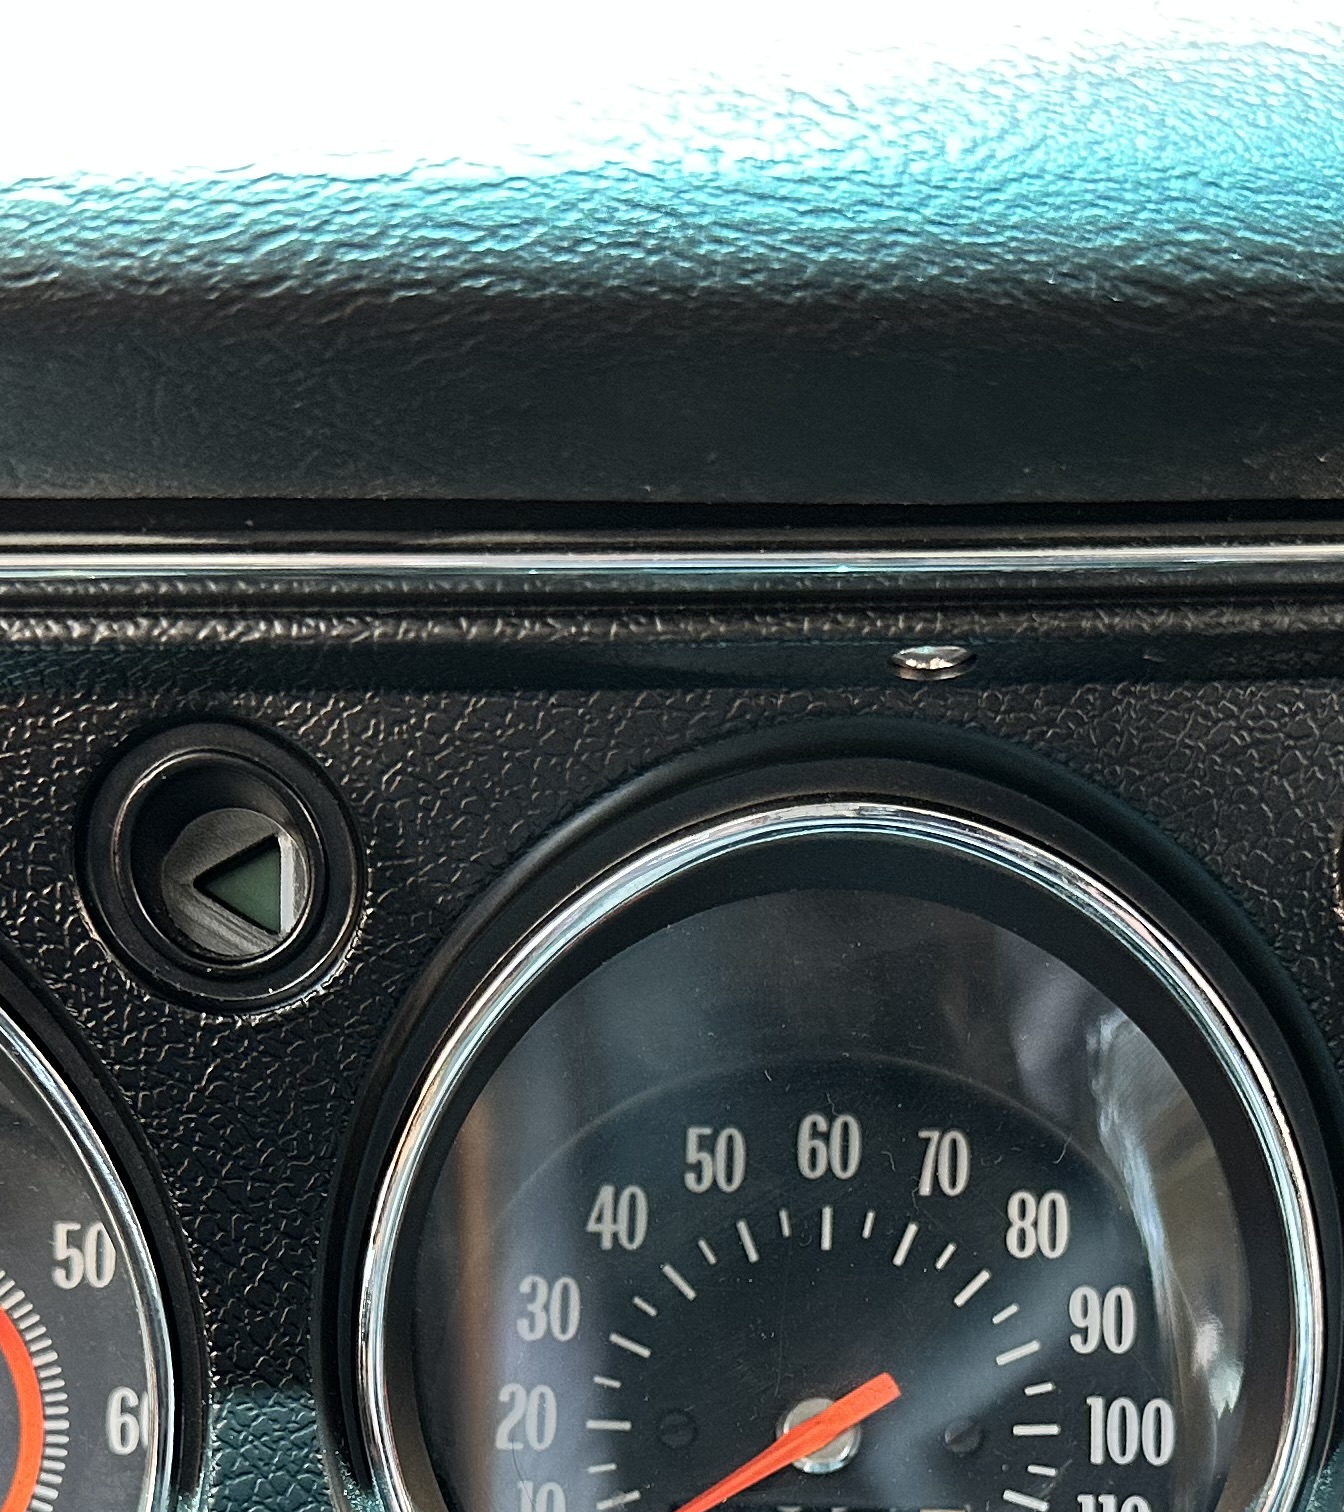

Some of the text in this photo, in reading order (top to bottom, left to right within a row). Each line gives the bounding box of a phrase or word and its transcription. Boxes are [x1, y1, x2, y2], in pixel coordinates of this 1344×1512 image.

[684, 1127, 746, 1193] 50
[797, 1114, 861, 1180] 60
[917, 1130, 970, 1197] 70
[586, 1185, 648, 1251] 40
[1006, 1191, 1069, 1259] 80
[53, 1221, 116, 1288] 50
[517, 1276, 580, 1341] 30
[1069, 1286, 1134, 1355] 90
[495, 1384, 557, 1452] 20
[1086, 1397, 1174, 1465] 100
